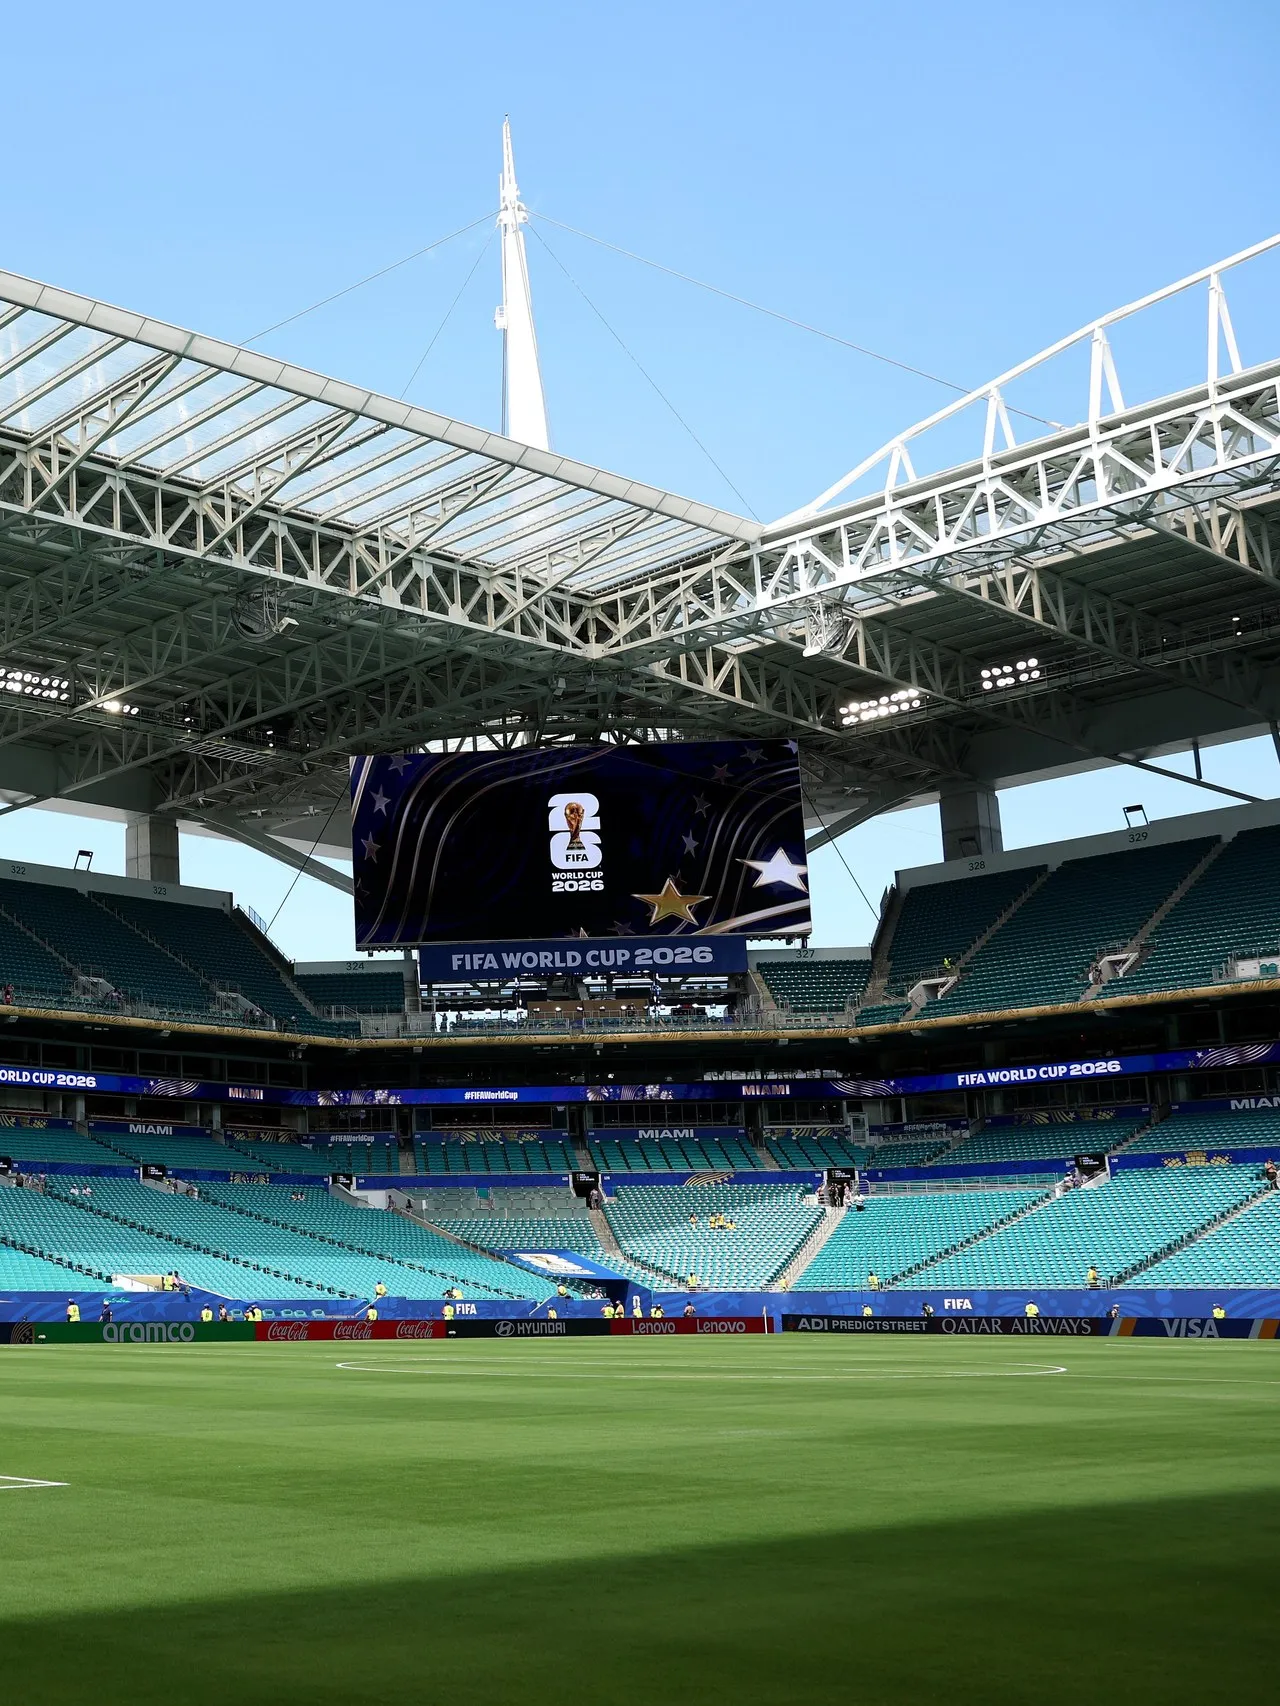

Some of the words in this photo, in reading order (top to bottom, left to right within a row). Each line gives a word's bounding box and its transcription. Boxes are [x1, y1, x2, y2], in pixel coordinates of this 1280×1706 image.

[1129, 831, 1149, 844] 329
[565, 854, 589, 863] FIFA
[11, 865, 26, 875] 322
[969, 860, 986, 872] 328
[552, 872, 585, 880] WORLD
[586, 871, 604, 879] CUP
[153, 886, 167, 896] 323
[552, 880, 605, 892] 2026
[452, 953, 499, 971] FIFA
[502, 951, 582, 969] WORLD
[586, 949, 631, 967] CUP
[634, 947, 713, 965] 2026
[795, 950, 815, 959] 327
[346, 962, 365, 971] 324
[957, 1073, 986, 1086] FIFA
[988, 1068, 1037, 1083] WORLD
[1039, 1065, 1068, 1079] CUP
[1069, 1061, 1121, 1076] 2026
[33, 1072, 56, 1085] CUP
[57, 1075, 97, 1088] 2026
[228, 1087, 264, 1100] MIAMI
[464, 1091, 518, 1101] #FIFAWorldCup
[742, 1085, 790, 1096] MIAMI
[129, 1124, 173, 1136] MIAMI
[904, 1122, 947, 1132] #FIFAWorldCup
[330, 1135, 375, 1143] #FIFAWorldCup
[638, 1129, 695, 1139] MIAMI
[456, 1303, 478, 1315] FIFA
[944, 1299, 973, 1310] FIFA
[333, 1321, 375, 1340] Coca-Cola
[396, 1321, 436, 1339] Coca-Cola
[517, 1322, 566, 1335] HYUNDAI
[632, 1320, 676, 1334] Lenovo
[697, 1318, 746, 1333] Lenovo
[798, 1318, 828, 1331] ADI
[832, 1319, 928, 1332] PREDICTSTREET
[942, 1318, 1003, 1335] QATAR
[1011, 1318, 1092, 1335] AIRWAYS
[1158, 1318, 1221, 1338] VISA
[103, 1323, 195, 1343] aramco
[268, 1322, 310, 1341] Coca-Cola
